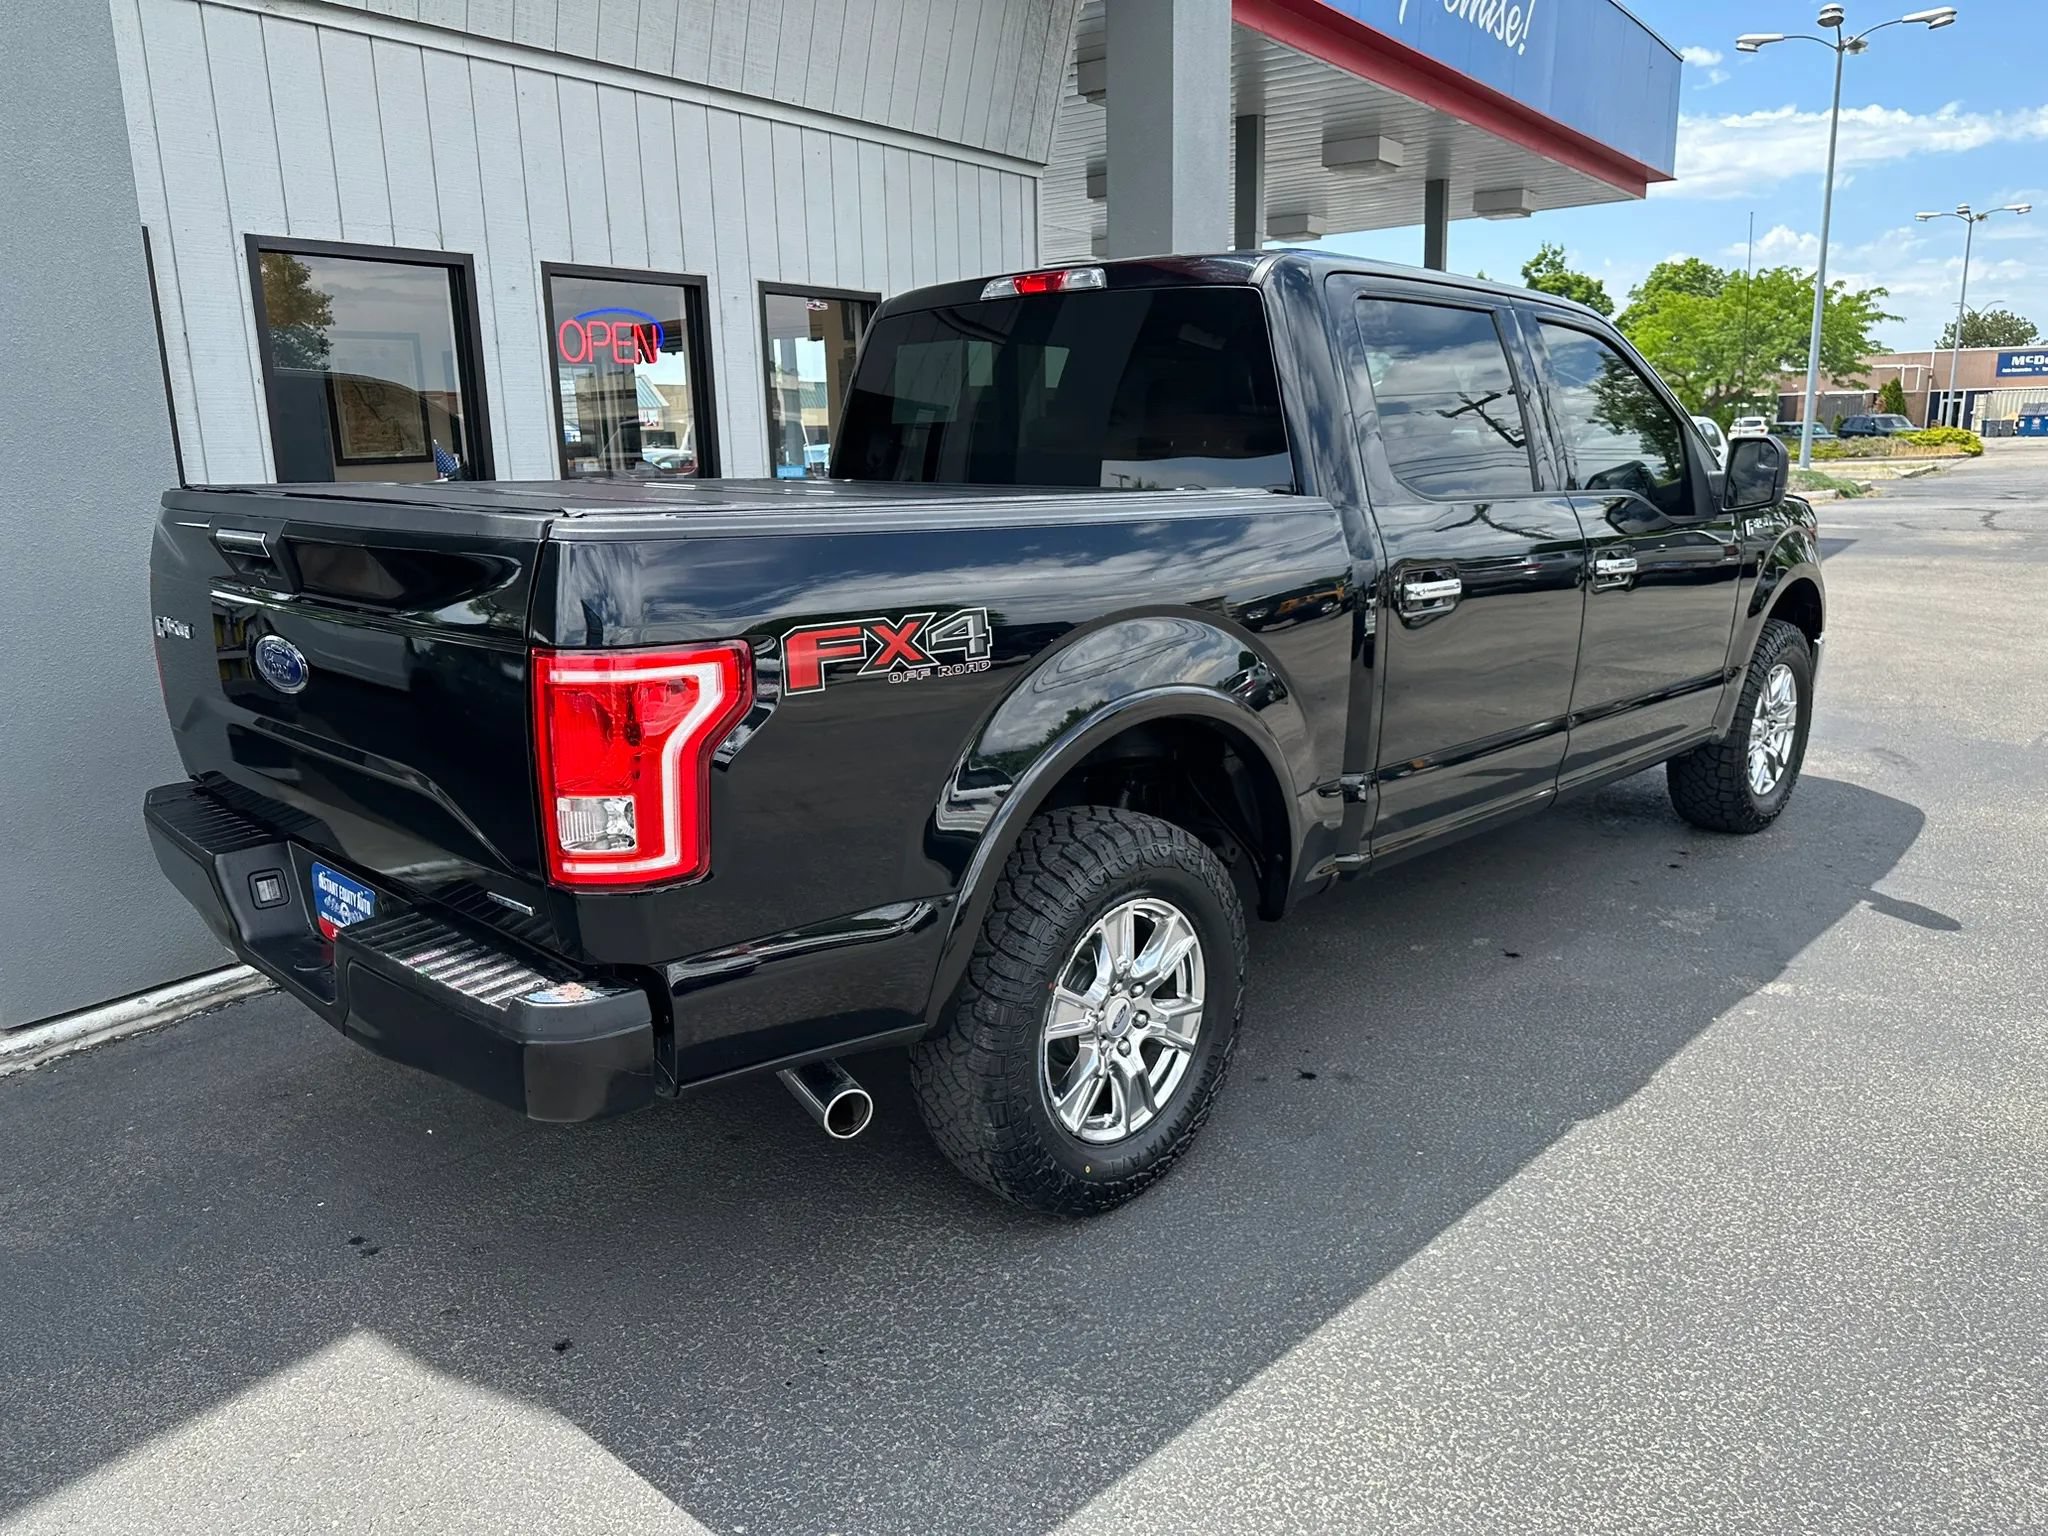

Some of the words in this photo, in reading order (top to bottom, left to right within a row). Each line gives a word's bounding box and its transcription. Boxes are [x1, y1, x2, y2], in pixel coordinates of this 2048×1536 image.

[558, 319, 659, 364] OPEN
[780, 607, 993, 696] FX4
[888, 668, 931, 683] OFF
[938, 660, 992, 677] ROAD
[356, 891, 371, 916] AUTO
